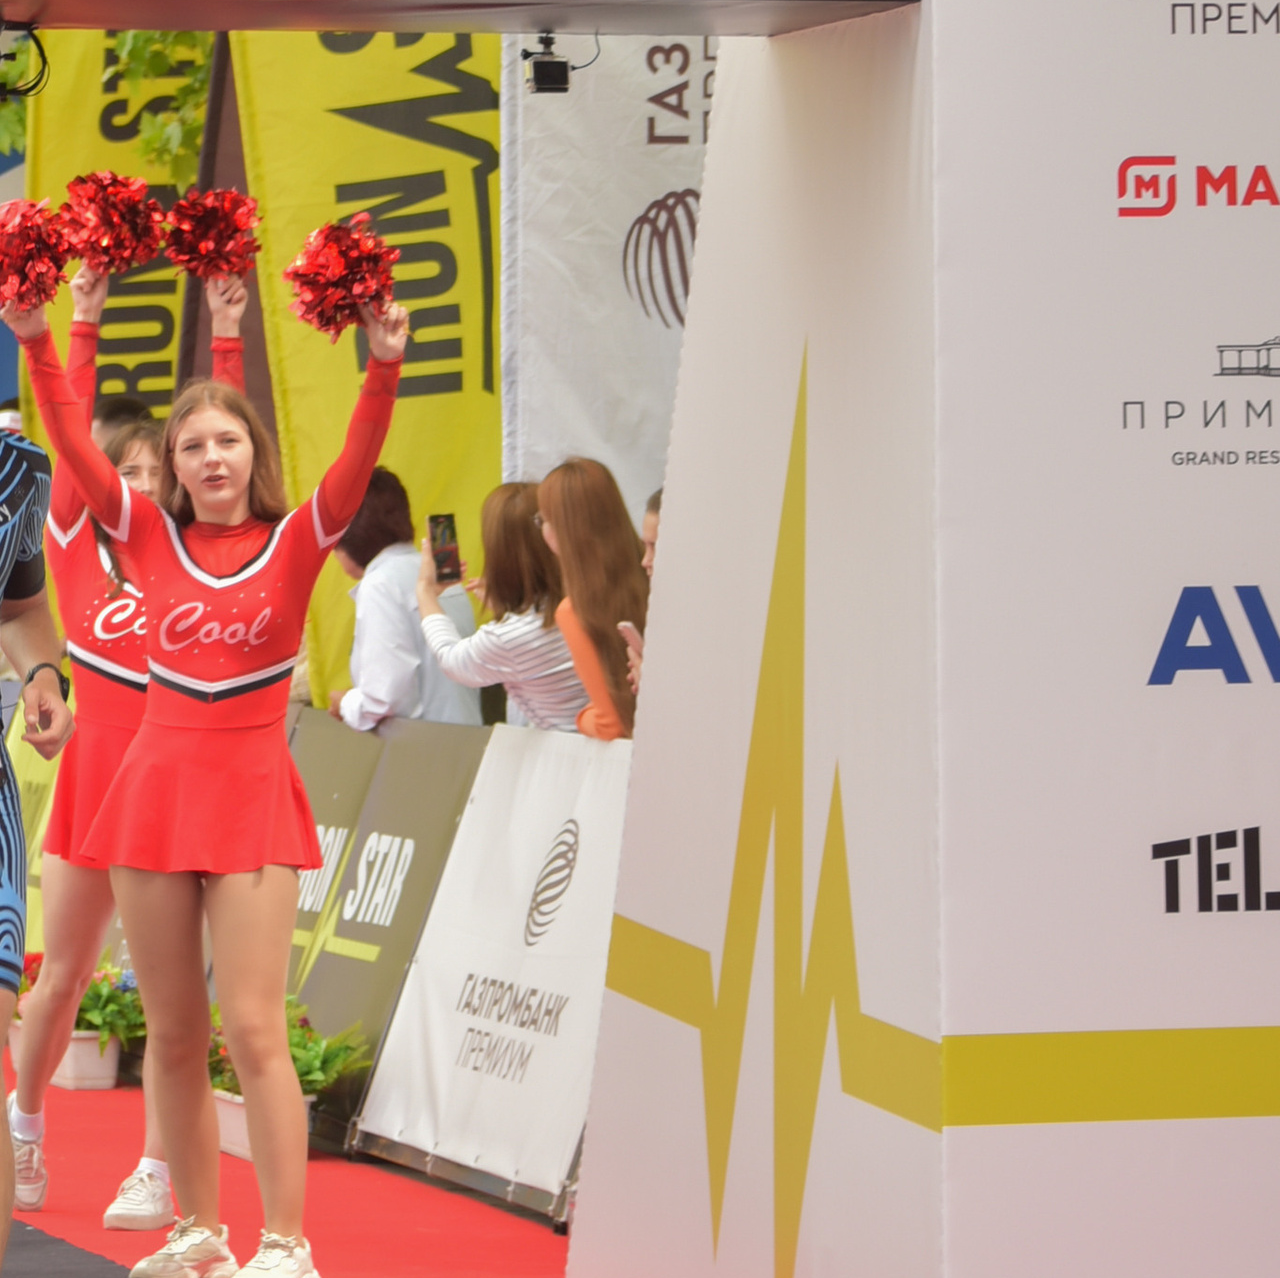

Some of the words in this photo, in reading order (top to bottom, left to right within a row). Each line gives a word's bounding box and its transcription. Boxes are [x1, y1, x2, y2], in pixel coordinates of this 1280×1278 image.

[1171, 450, 1240, 467] GRAND
[159, 601, 273, 652] Cool
[342, 831, 415, 927] STAR
[455, 973, 570, 1037] ГАЗПРОМБАНК
[454, 1027, 535, 1083] ПРЕМИУМ
